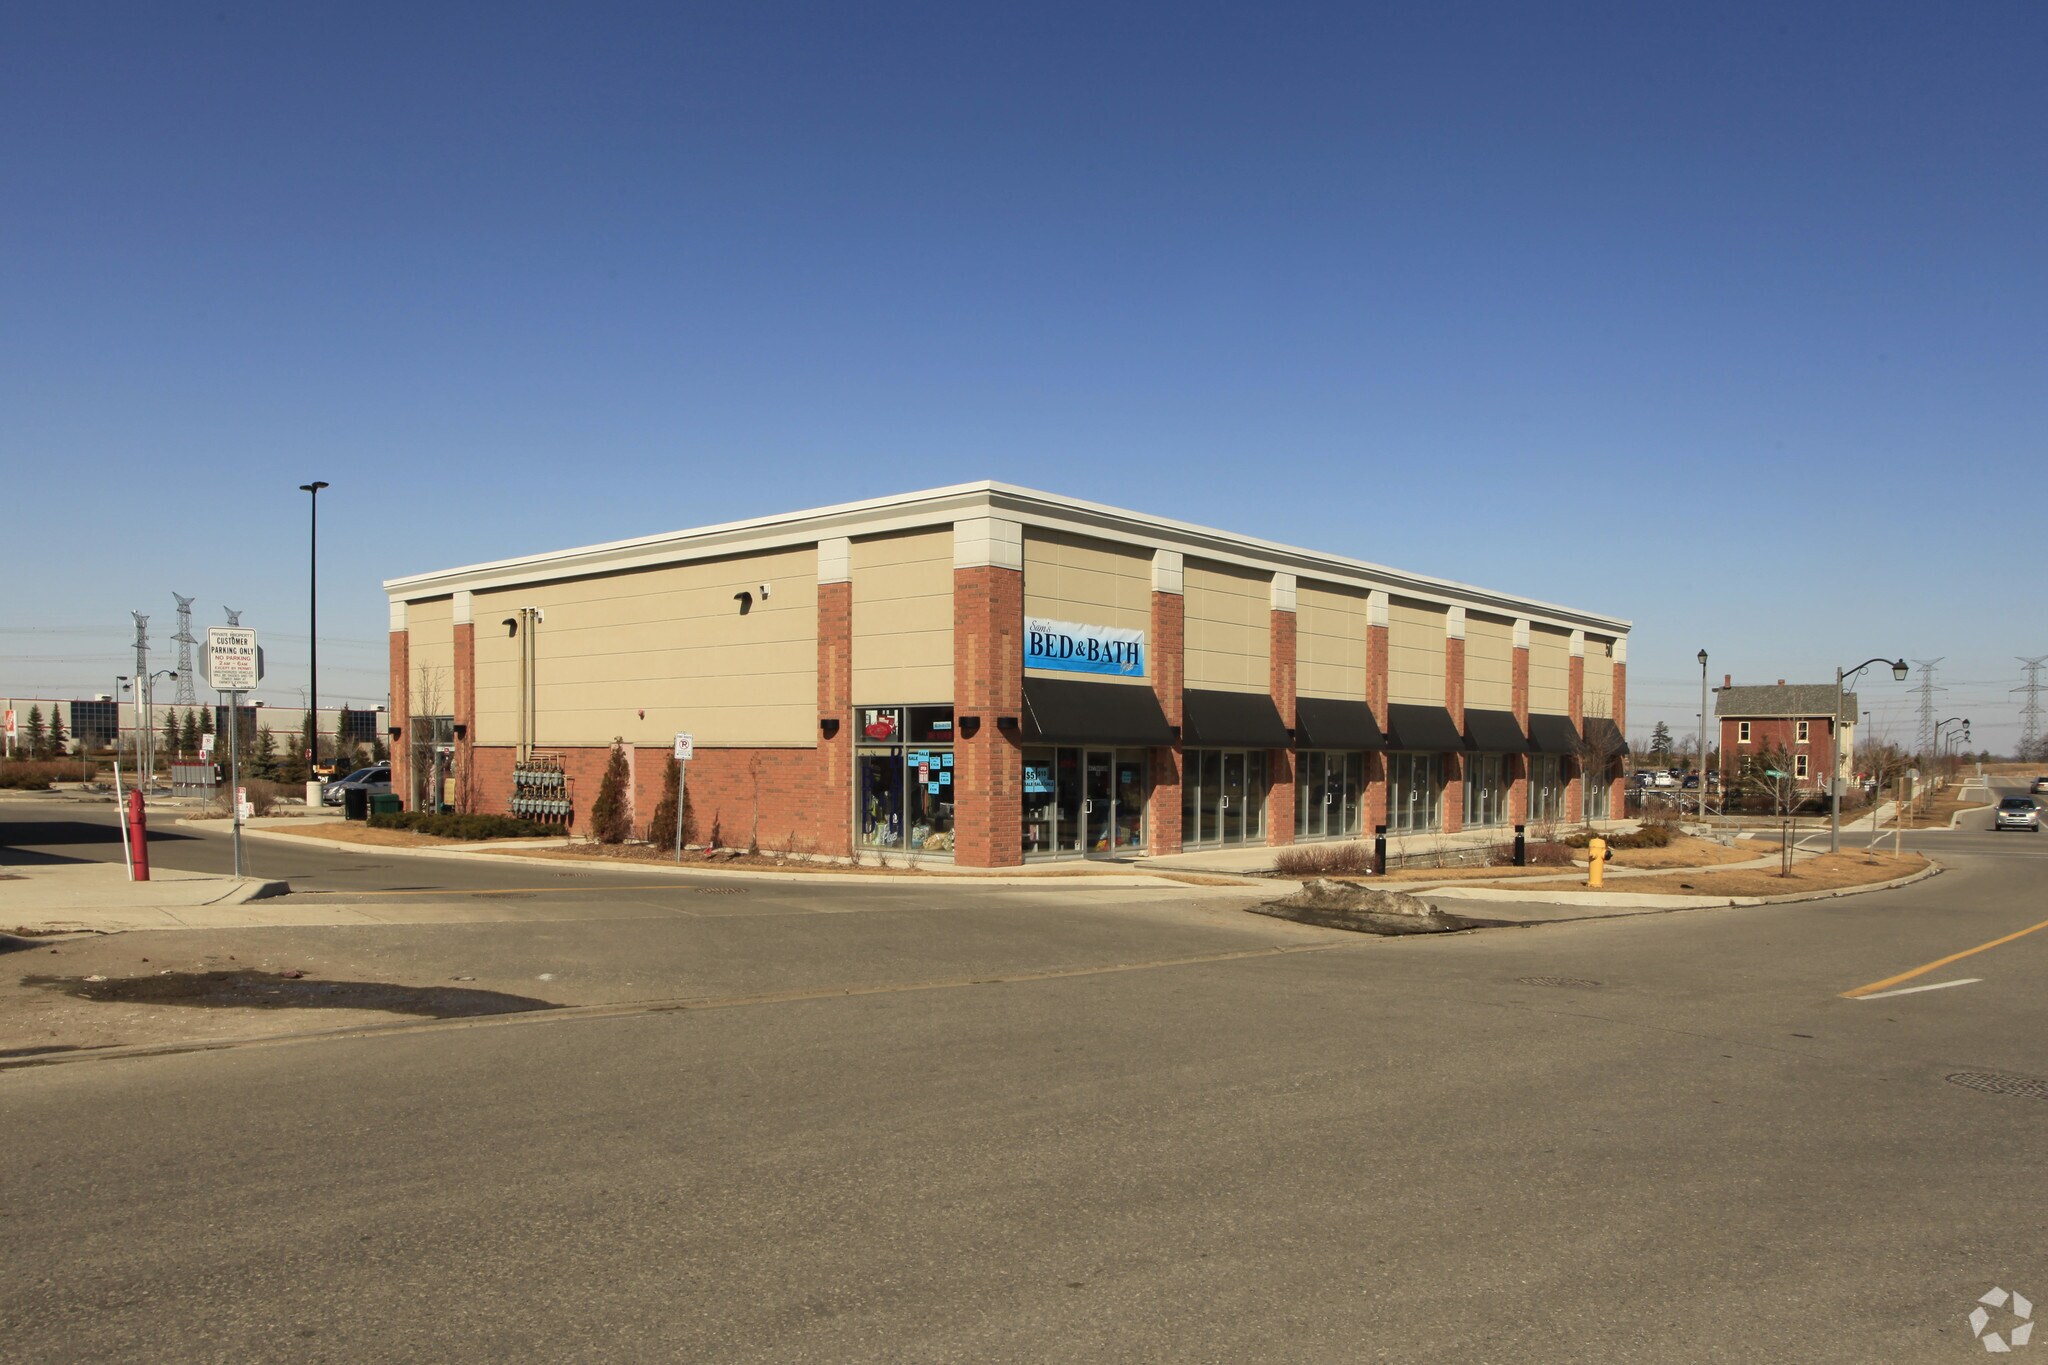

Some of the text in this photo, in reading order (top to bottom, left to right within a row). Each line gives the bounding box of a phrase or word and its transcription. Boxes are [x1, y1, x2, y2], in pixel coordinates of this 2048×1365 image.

[1029, 620, 1051, 632] Sam's
[217, 637, 248, 645] CUSTOMER
[211, 646, 238, 654] PARKING
[1029, 631, 1140, 665] BED & BATH
[1026, 771, 1035, 780] $5
